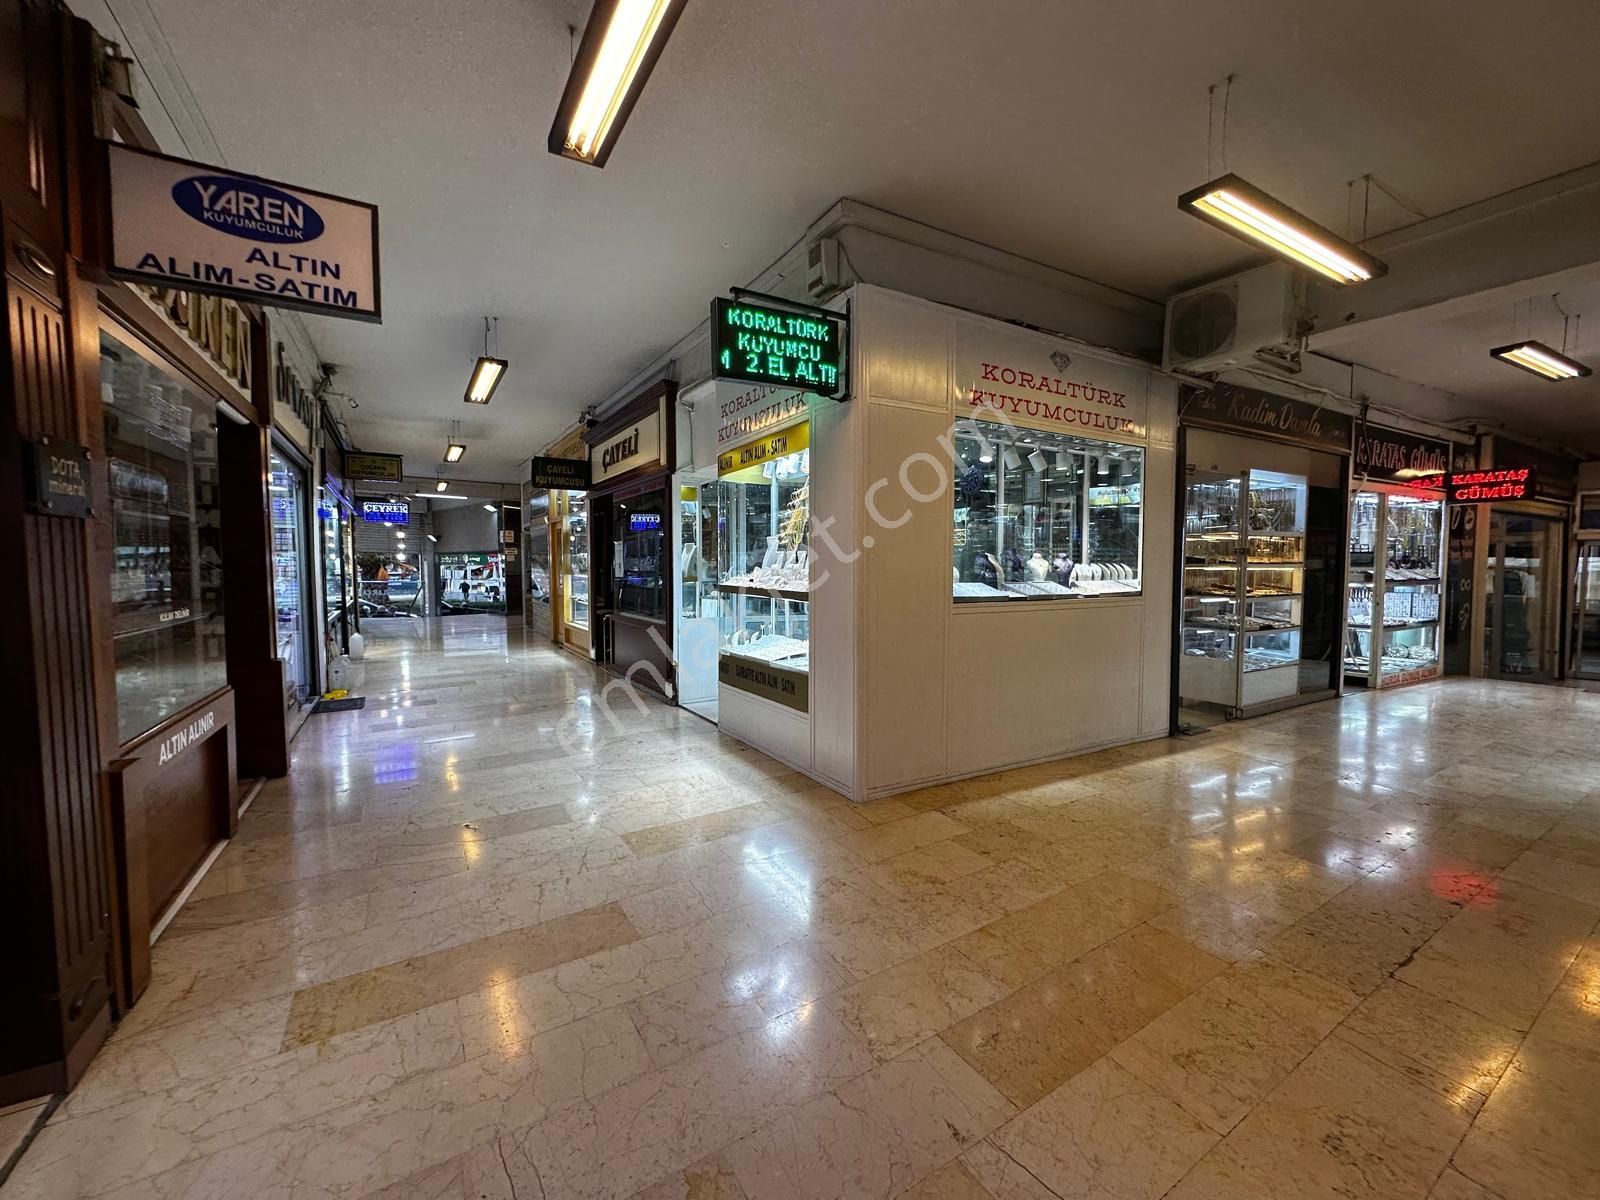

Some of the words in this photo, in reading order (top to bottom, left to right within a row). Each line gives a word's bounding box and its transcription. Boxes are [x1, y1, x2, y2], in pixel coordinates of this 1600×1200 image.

[193, 180, 304, 228] YAREN
[203, 209, 304, 239] KUYUMCULUK
[245, 247, 341, 280] ALTIN
[137, 252, 358, 308] ALIM-SATIM
[727, 308, 829, 341] KORALTÜRK
[738, 332, 821, 362] KUYUMCU
[768, 357, 790, 378] EL
[981, 363, 1126, 409] KORALTÜRK
[718, 392, 807, 442] KUYUMCULUK
[969, 388, 1134, 432] KUYUMCULUK
[602, 428, 640, 474] ÇAYELİ
[740, 448, 754, 465] ALTIN
[770, 435, 787, 456] SATIM
[51, 456, 81, 479] DOTA
[535, 474, 585, 487] KUYUMCUSU
[547, 464, 574, 475] ÇAYELİ
[1451, 469, 1529, 486] KARATAŞ
[1455, 484, 1525, 500] GÜMÜŞ
[159, 728, 187, 765] ALTIN
[187, 711, 215, 746] ALINIR
